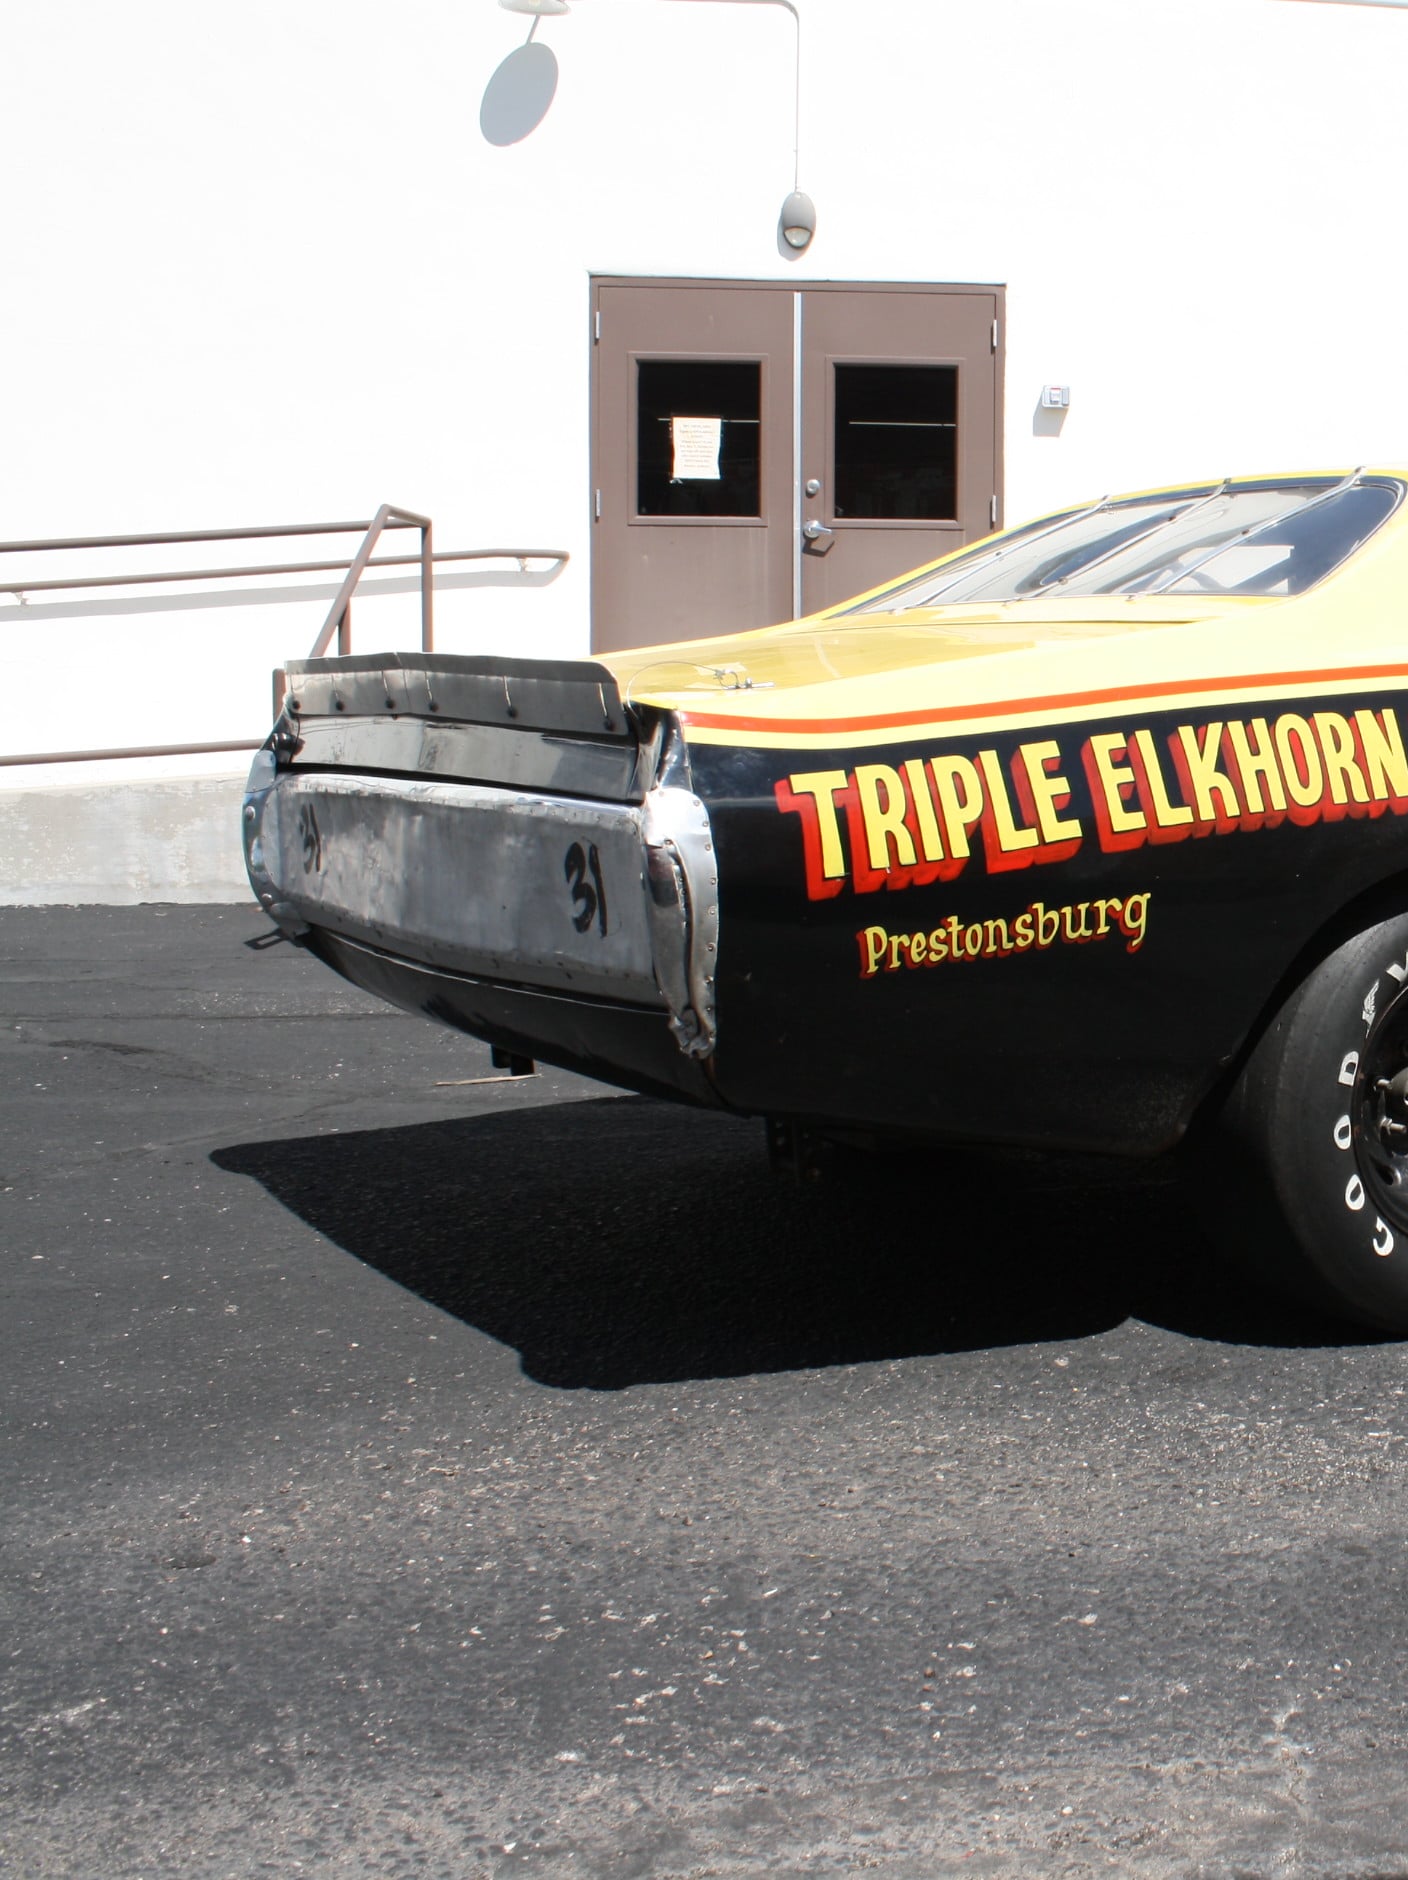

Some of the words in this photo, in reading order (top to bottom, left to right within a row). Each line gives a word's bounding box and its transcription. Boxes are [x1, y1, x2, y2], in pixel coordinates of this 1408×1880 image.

[784, 740, 1082, 886] TRIPLE
[564, 840, 608, 938] 31
[864, 892, 1152, 974] Prestonsburg
